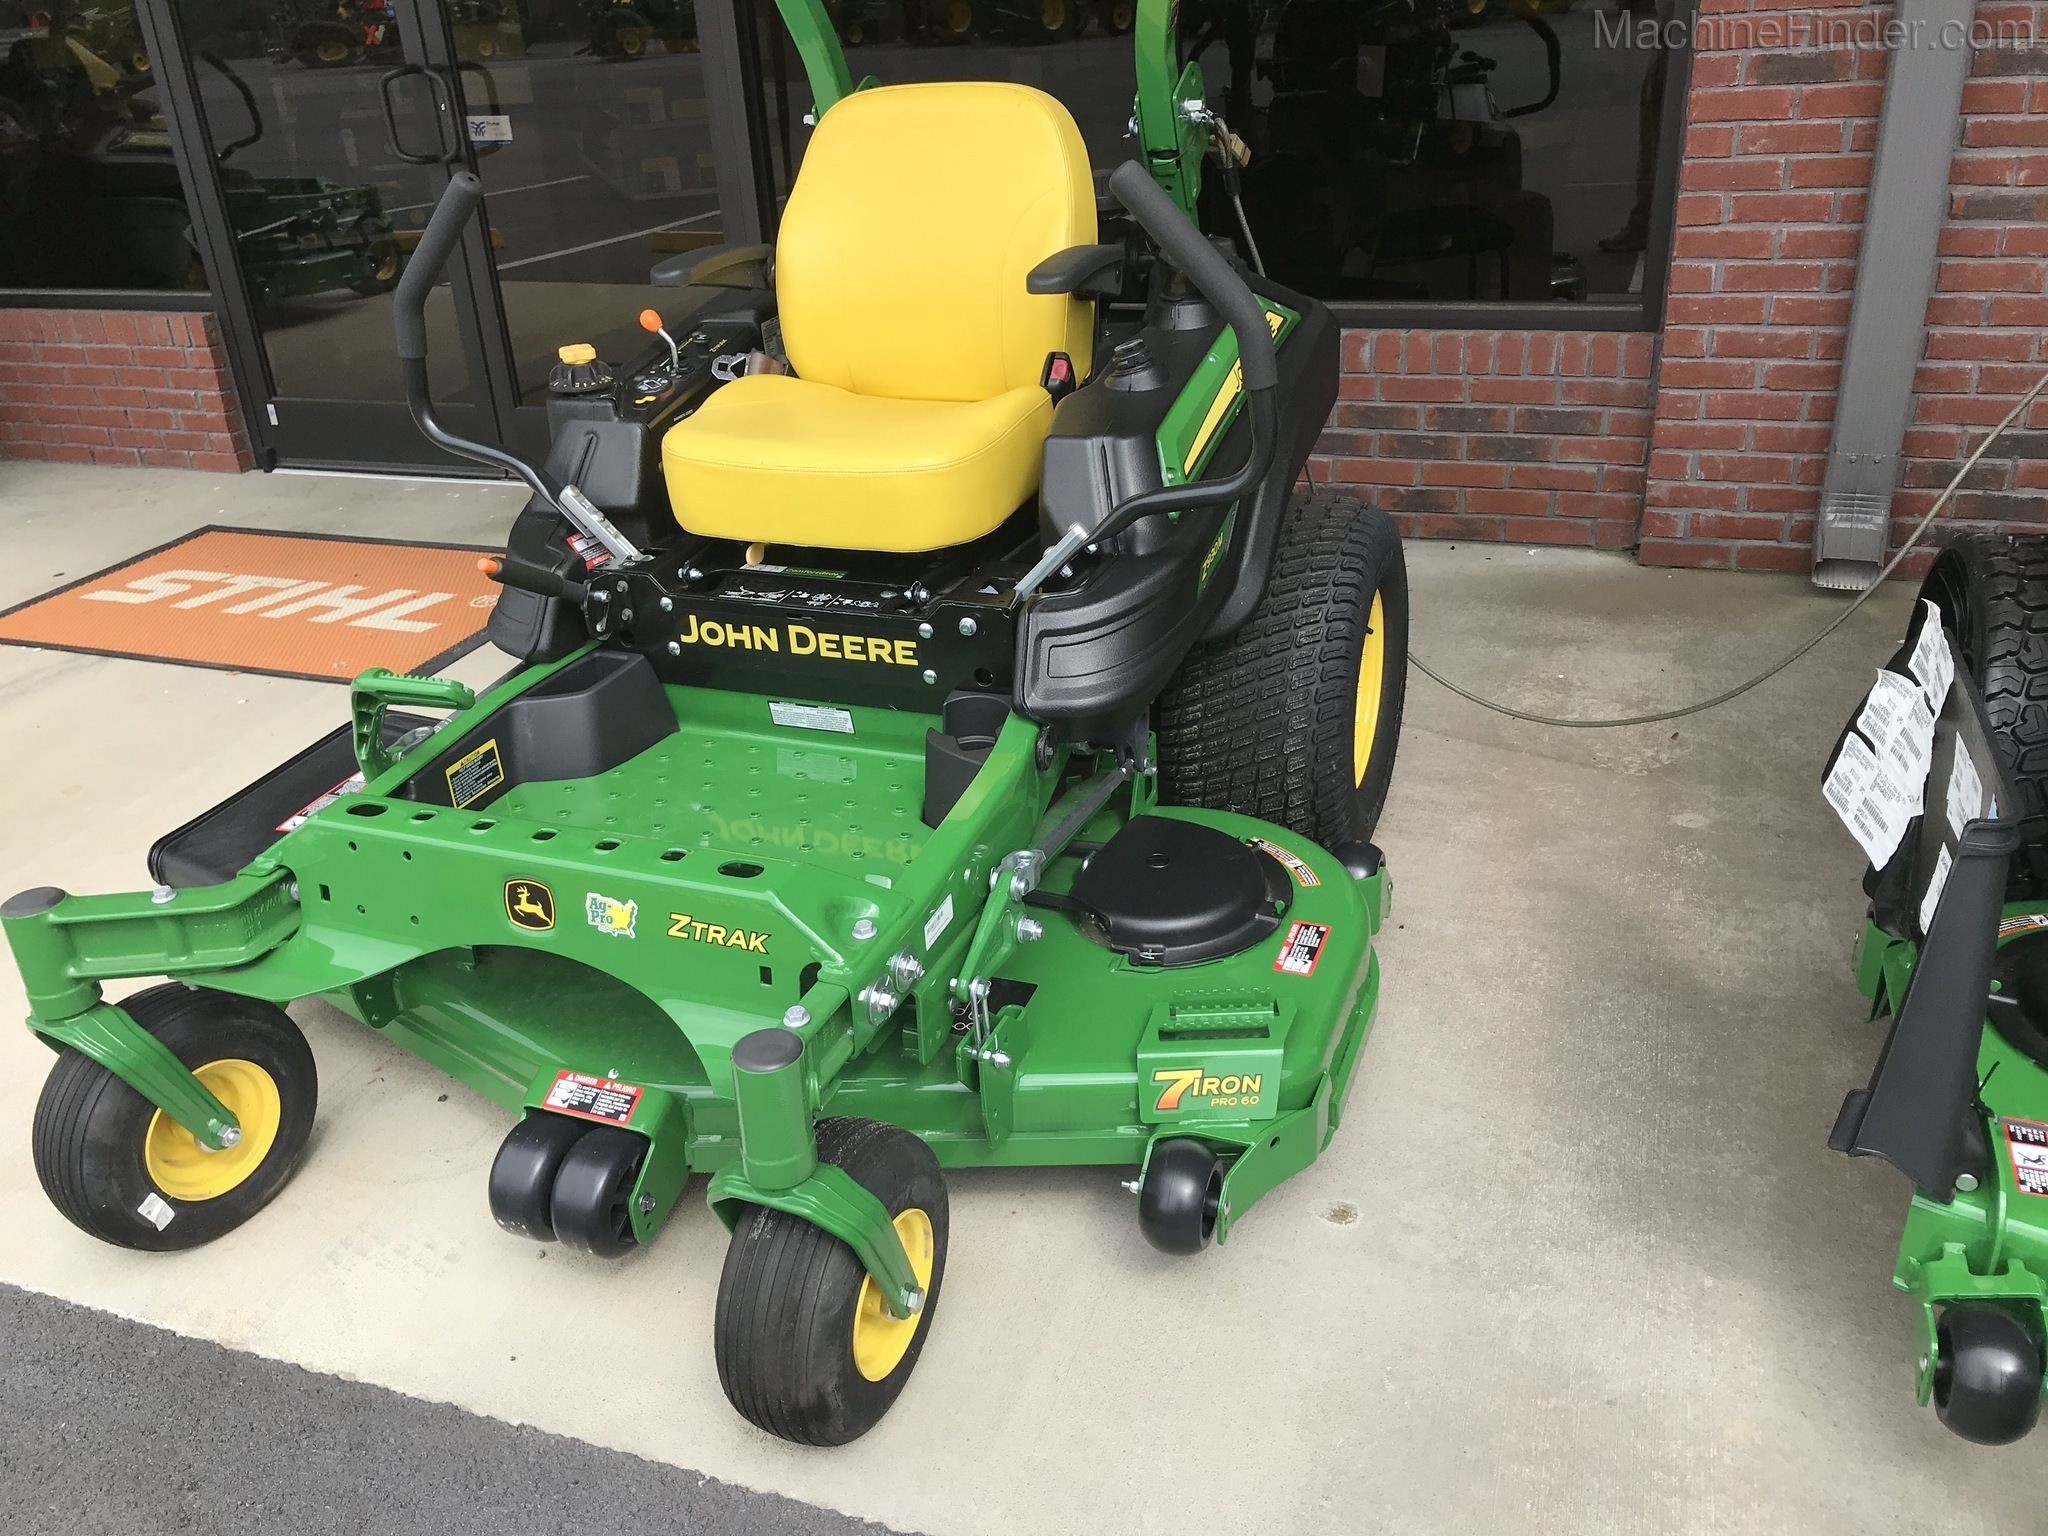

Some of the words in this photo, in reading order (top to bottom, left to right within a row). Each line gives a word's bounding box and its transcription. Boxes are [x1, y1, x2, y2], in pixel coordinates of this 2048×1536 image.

[81, 569, 457, 633] STIHL
[680, 614, 779, 652] JOHN
[787, 624, 919, 666] DEERE
[590, 910, 613, 924] Pro
[667, 912, 772, 954] ZTRAK
[573, 1074, 598, 1087] DANGER
[611, 1083, 637, 1095] PELIGRO
[1210, 1096, 1238, 1107] PRO
[1240, 1095, 1260, 1105] 60
